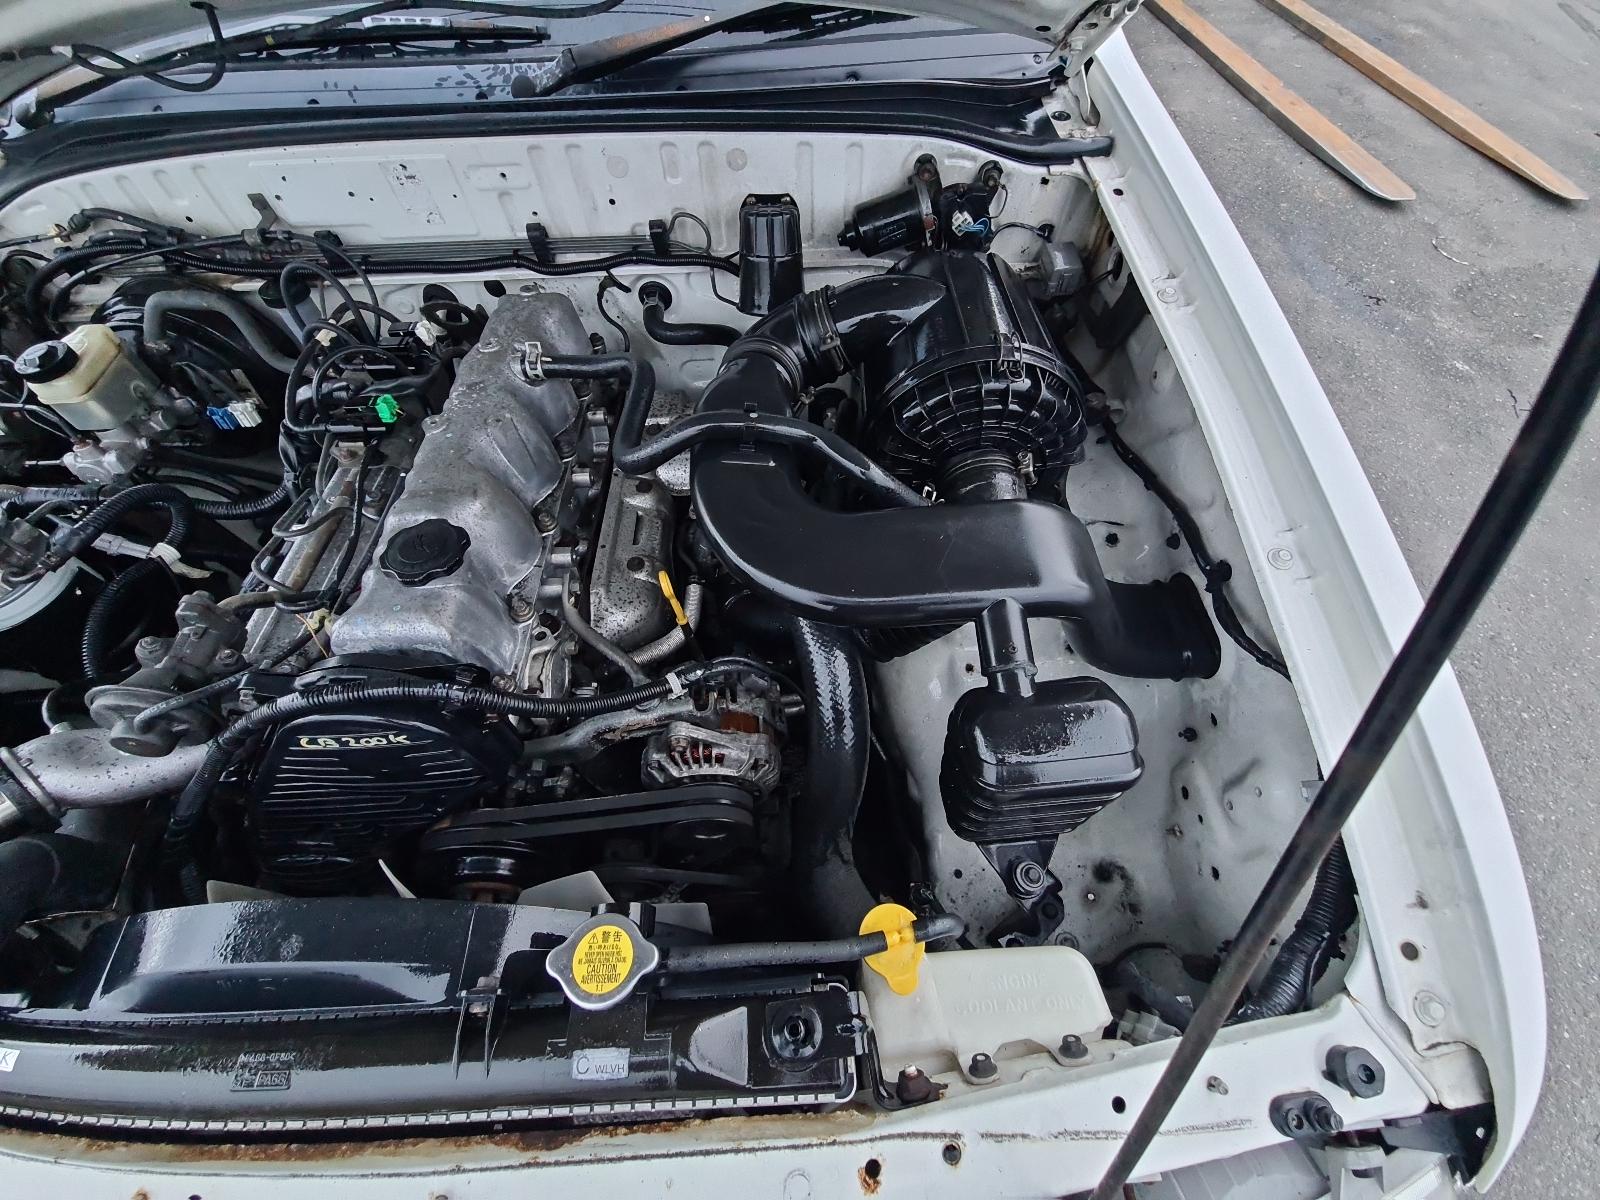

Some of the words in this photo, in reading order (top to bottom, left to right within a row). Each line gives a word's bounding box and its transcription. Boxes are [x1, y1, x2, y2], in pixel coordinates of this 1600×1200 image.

[586, 963, 618, 975] CAUTION
[580, 973, 622, 985] AVERTISSEMENT
[576, 1056, 590, 1075] C
[594, 1063, 625, 1075] WLVH
